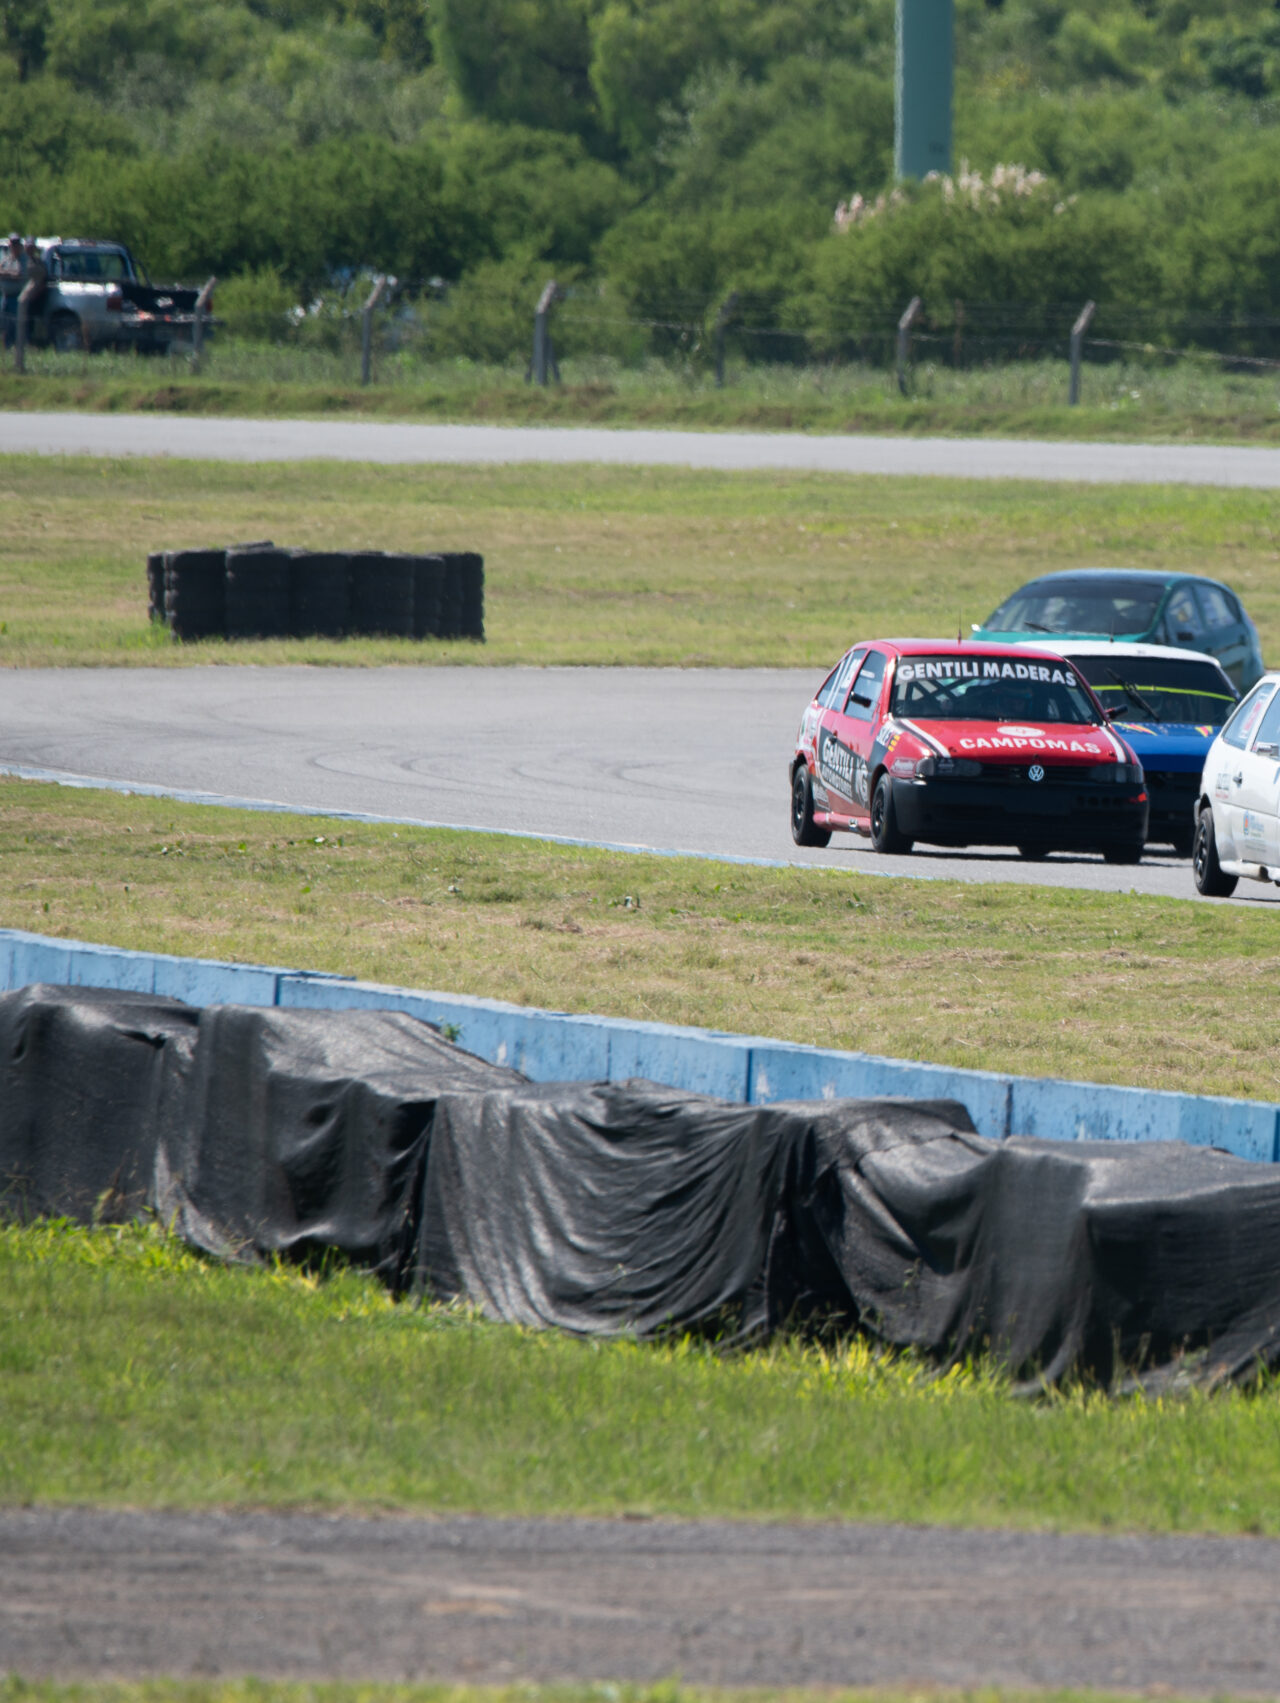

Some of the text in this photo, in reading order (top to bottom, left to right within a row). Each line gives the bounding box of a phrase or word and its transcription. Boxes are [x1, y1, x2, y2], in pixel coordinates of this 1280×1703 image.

[898, 661, 979, 680] GENTILI
[983, 662, 1077, 687] MADERAS
[959, 736, 1102, 754] CAMPOMAS
